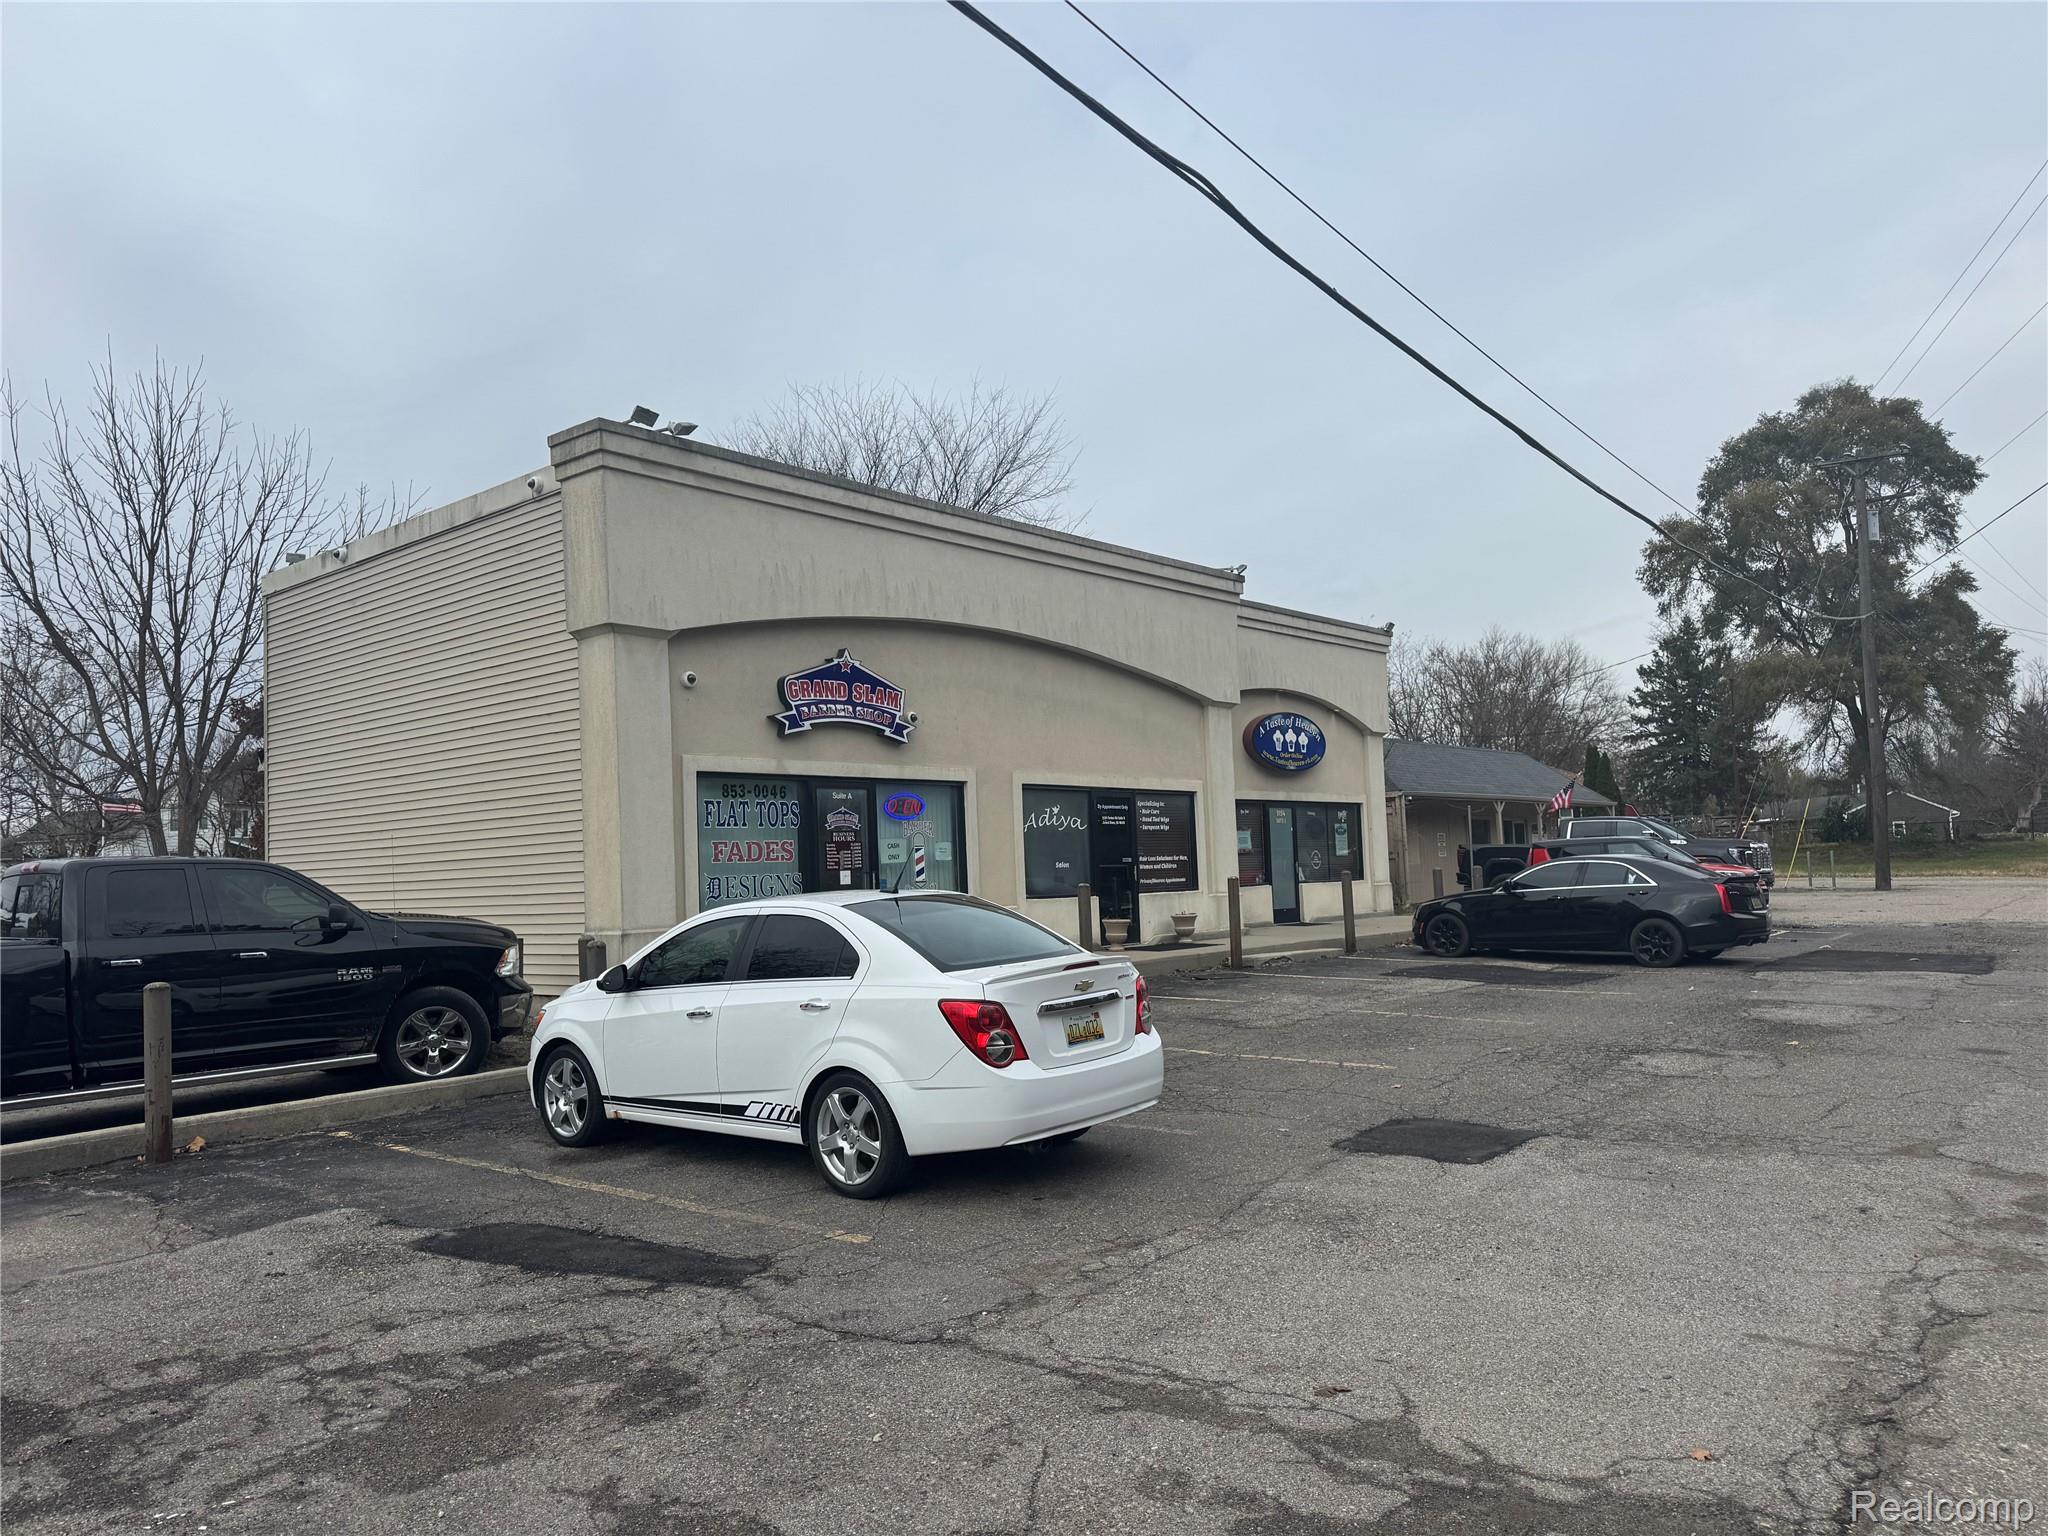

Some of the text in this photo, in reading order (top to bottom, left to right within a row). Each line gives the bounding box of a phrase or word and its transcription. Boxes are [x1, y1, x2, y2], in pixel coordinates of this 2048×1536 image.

[786, 679, 901, 710] GRAND SLAM
[800, 704, 893, 725] BARBER SHOP
[1260, 715, 1321, 742] A Taste of Heaven
[721, 783, 787, 799] 853-0046
[704, 799, 801, 829] FLAT TOPS
[887, 799, 921, 816] OEN
[1024, 805, 1088, 832] Adiya
[711, 840, 796, 863] FADES
[704, 873, 803, 904] DESIGNS
[337, 966, 374, 974] RAM
[337, 973, 374, 981] 1500
